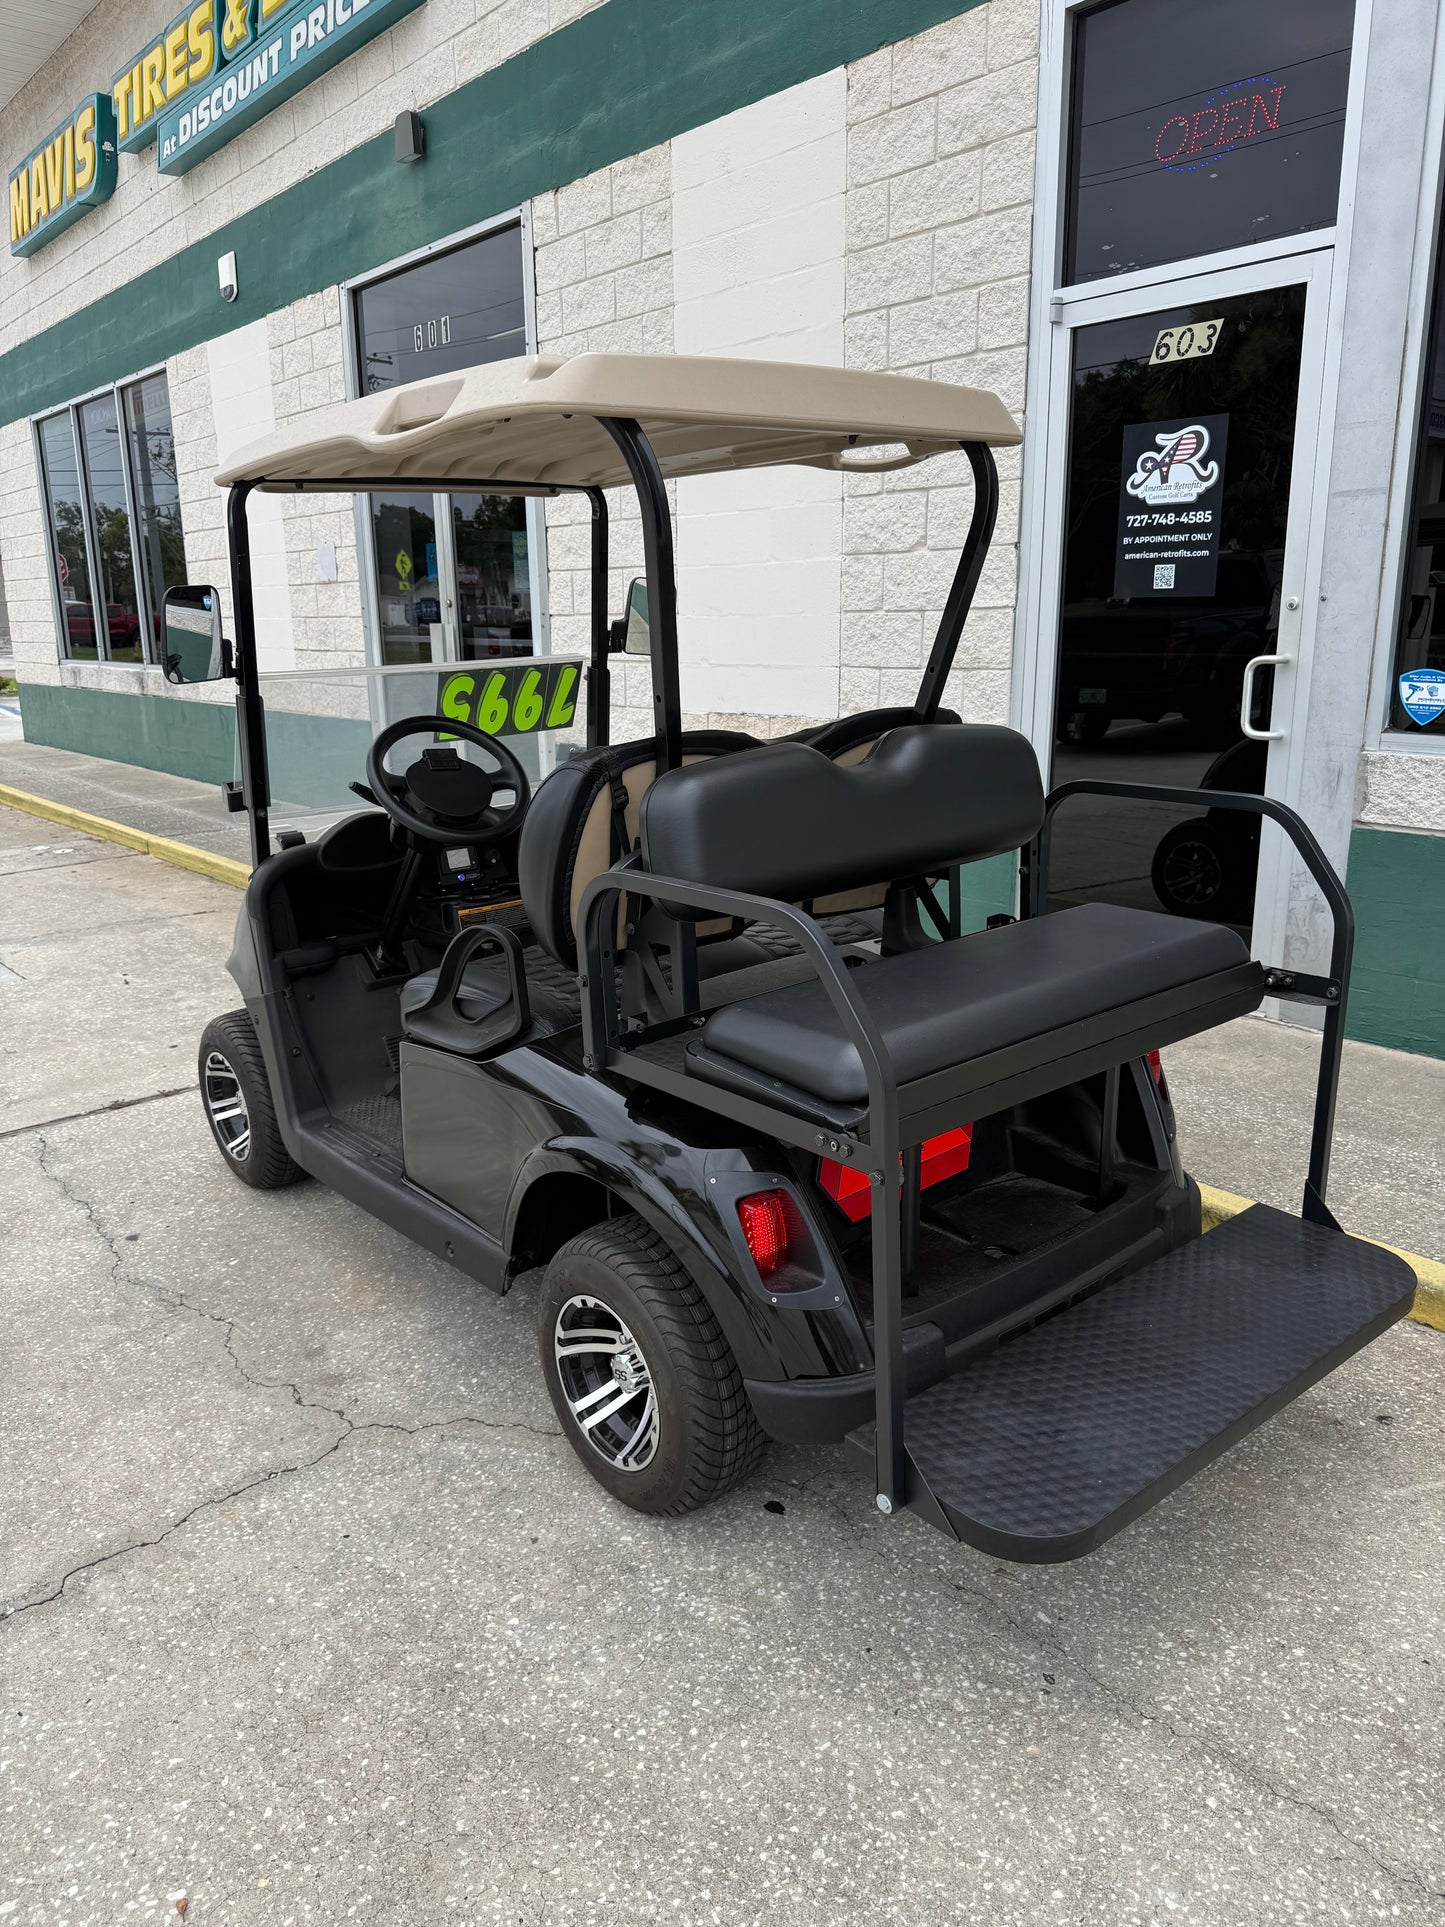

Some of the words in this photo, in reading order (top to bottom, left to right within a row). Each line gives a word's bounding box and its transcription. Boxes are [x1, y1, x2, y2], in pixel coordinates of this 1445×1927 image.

[162, 136, 177, 160] At
[178, 38, 283, 147] DISCOUNT
[10, 105, 96, 244] MAVIS
[113, 3, 214, 140] TIRES
[223, 0, 249, 49] &
[1154, 85, 1287, 162] OPEN
[414, 317, 450, 351] 601
[1156, 323, 1218, 360] 603
[1141, 484, 1172, 494] American
[1174, 480, 1202, 492] Retrofits
[1168, 491, 1179, 499] Golf
[1126, 511, 1212, 528] 727-748-4585
[1123, 537, 1134, 545] BY
[1134, 534, 1190, 544] APPOINTMENT
[1191, 532, 1213, 541] ONLY
[1124, 549, 1210, 560] american-retrofits.com
[614, 1368, 628, 1382] SS
